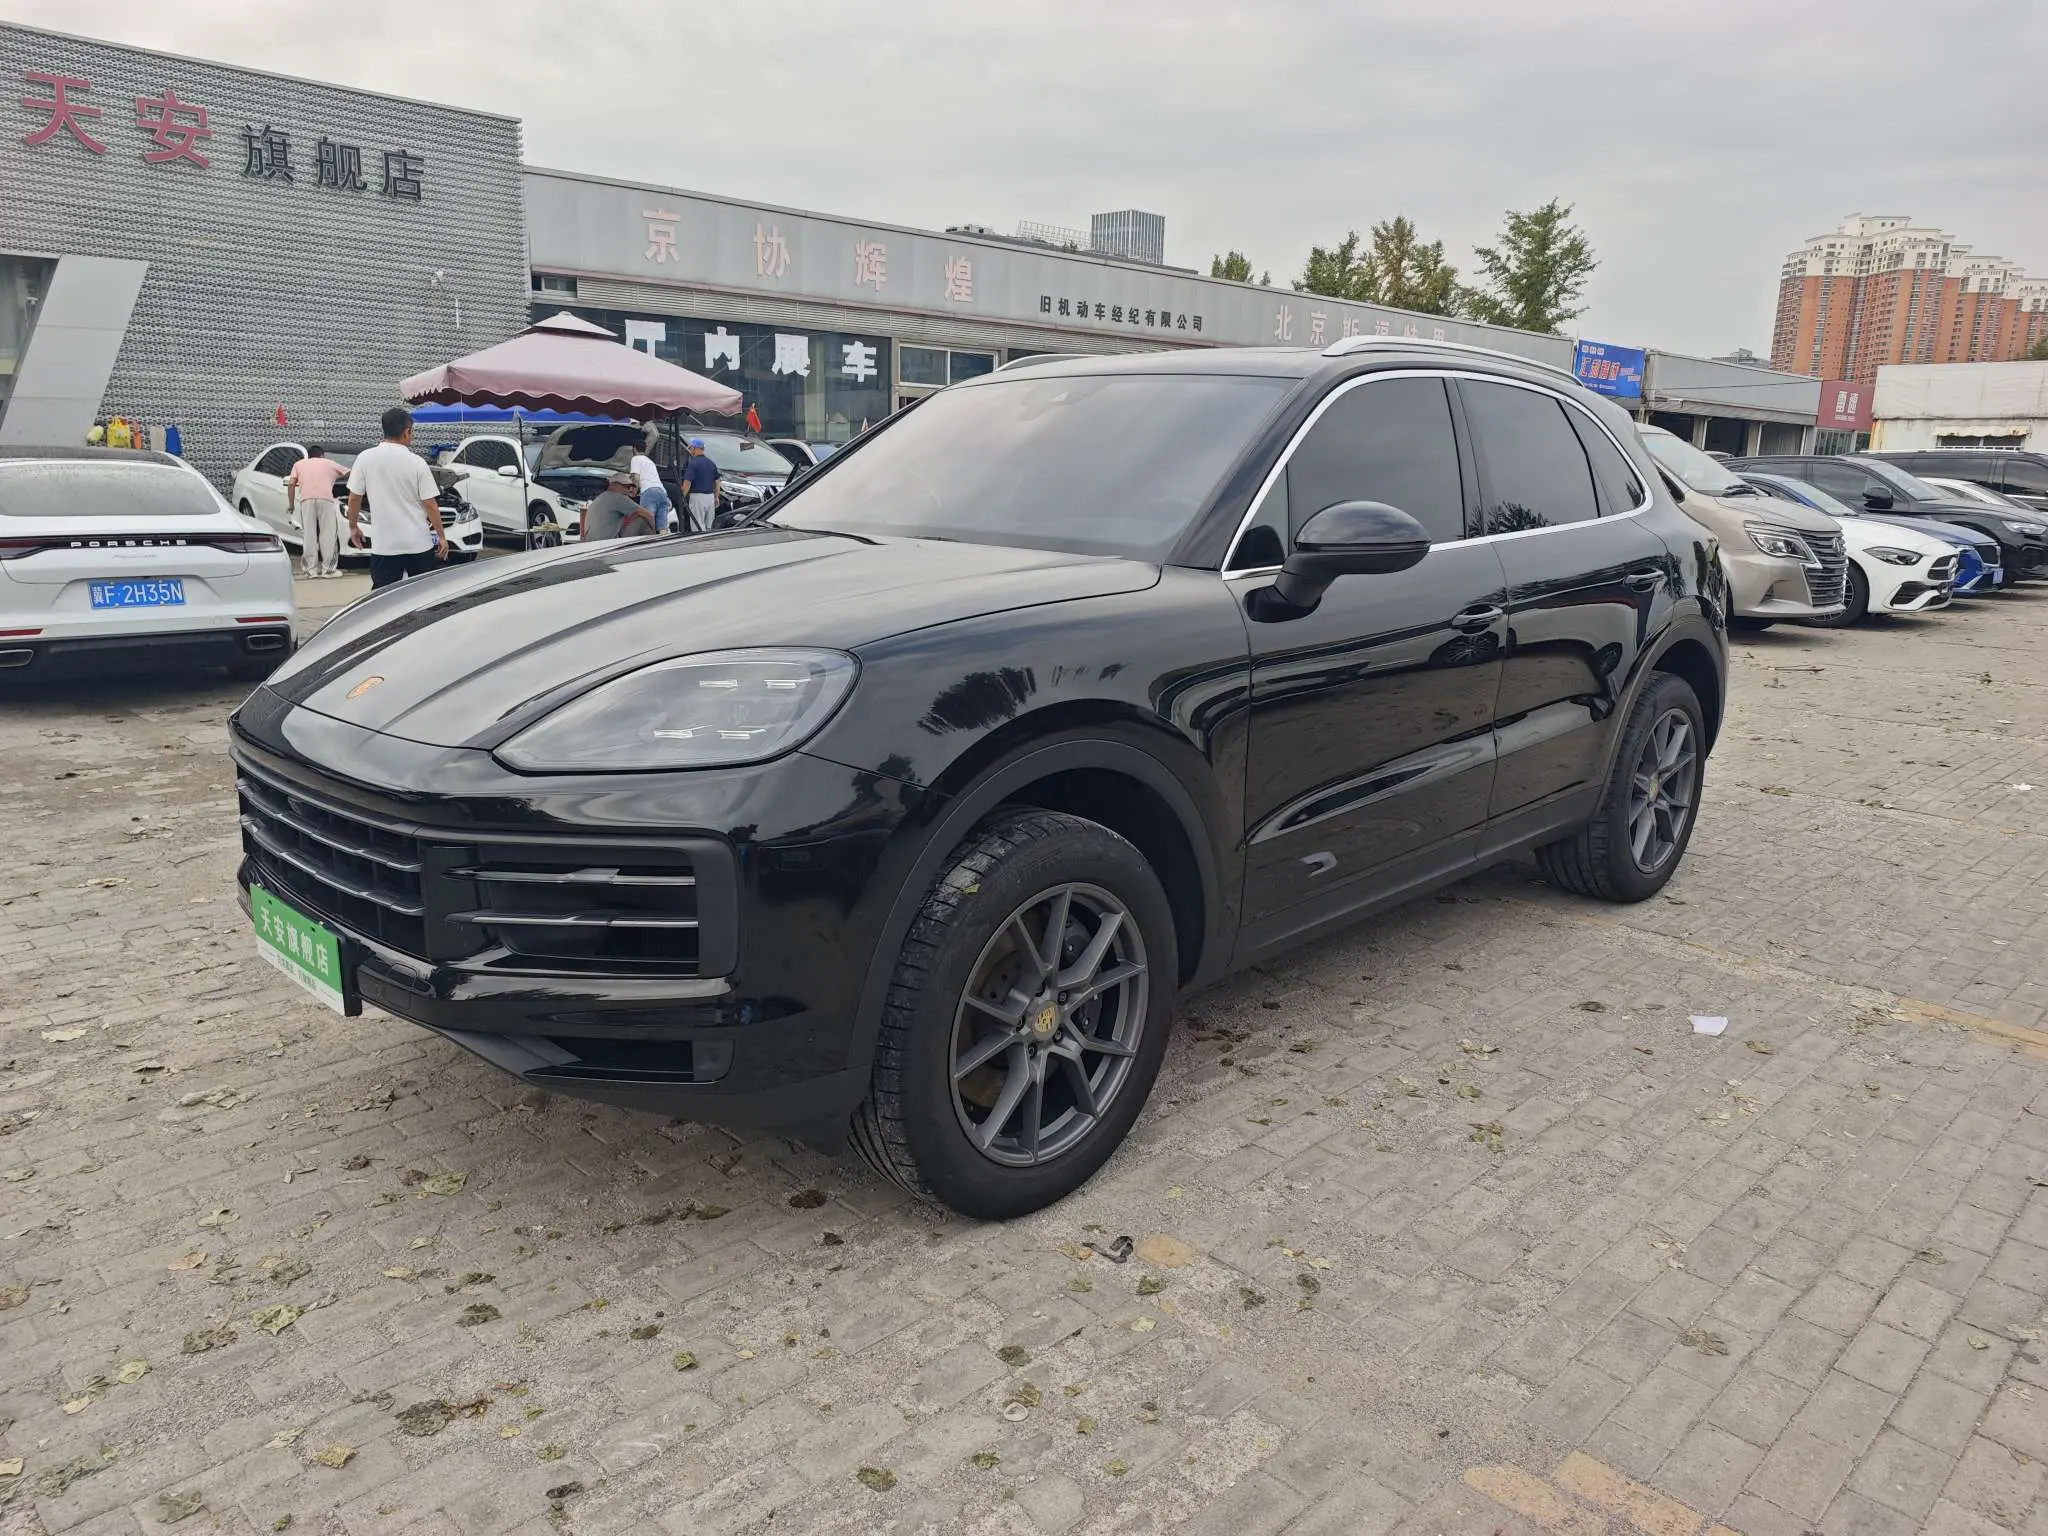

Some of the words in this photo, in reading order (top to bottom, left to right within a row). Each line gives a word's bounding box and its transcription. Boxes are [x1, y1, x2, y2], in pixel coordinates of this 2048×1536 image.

[21, 70, 215, 169] 天安
[242, 123, 425, 201] 旗舰店
[642, 207, 974, 303] 京协辉煌
[1039, 294, 1203, 332] 旧机动车经纪有限公司
[70, 539, 187, 548] PORSCHE
[260, 906, 330, 977] 天安旗舰店
